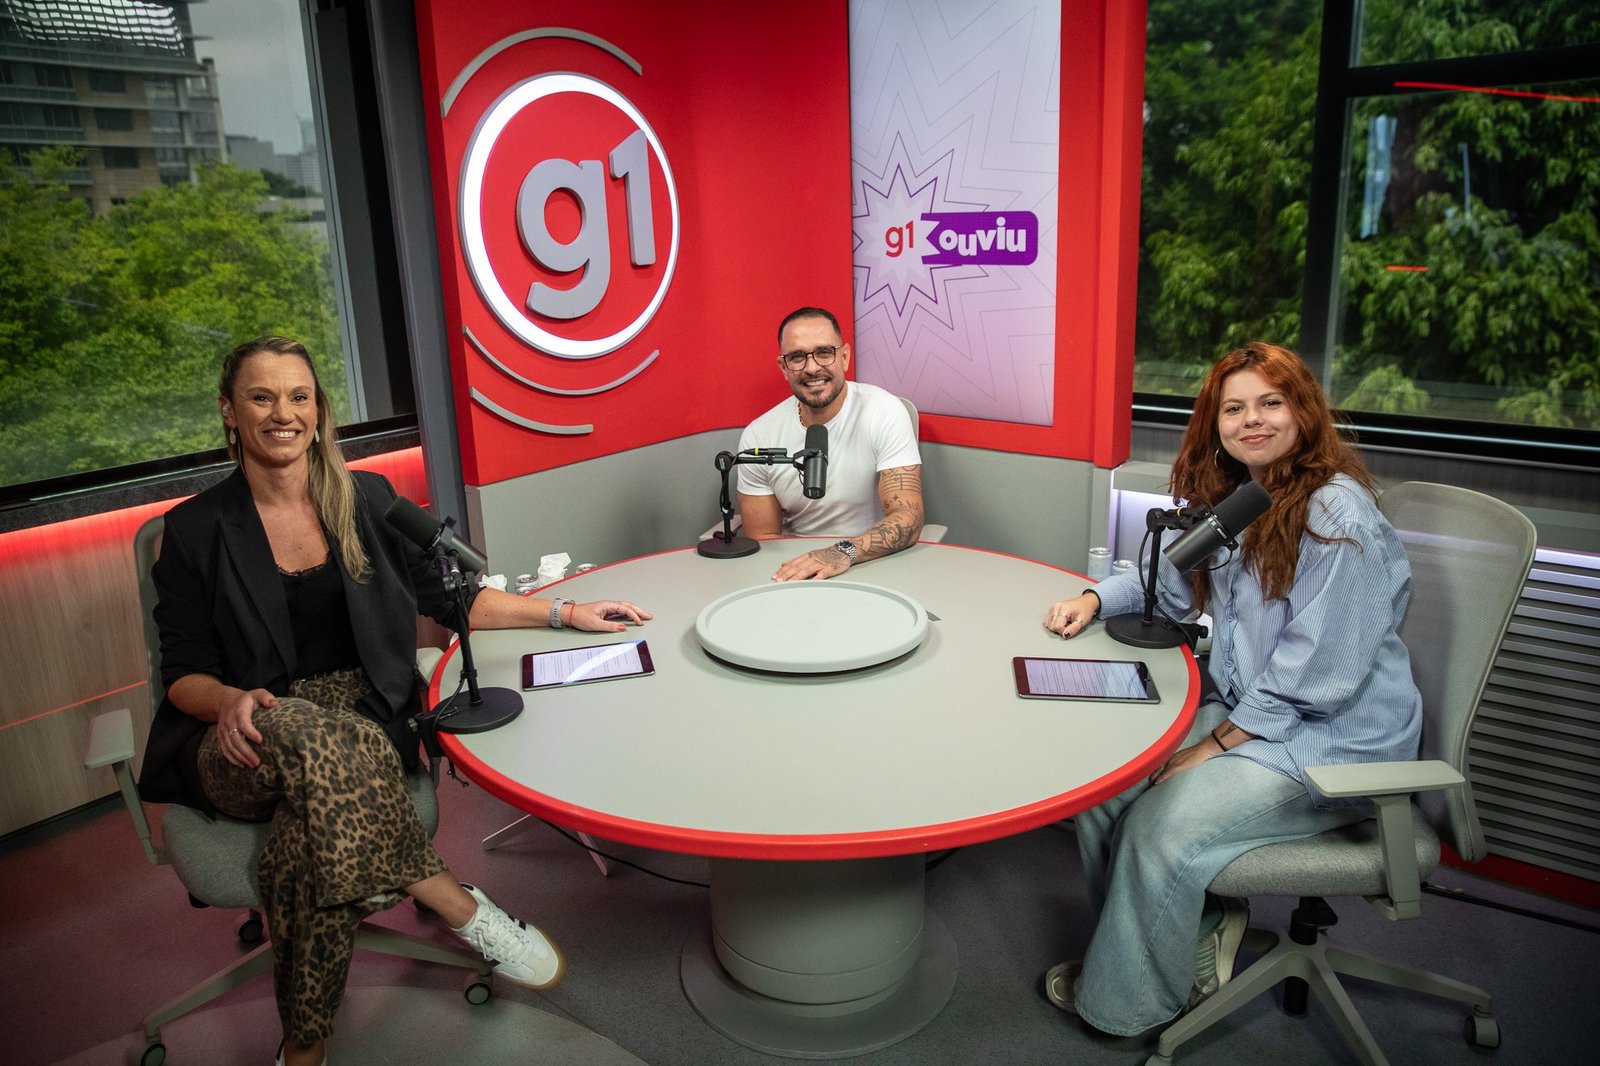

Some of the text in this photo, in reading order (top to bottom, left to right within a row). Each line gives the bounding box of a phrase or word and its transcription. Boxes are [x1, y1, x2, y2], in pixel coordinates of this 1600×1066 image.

[517, 129, 656, 319] g1
[885, 216, 1027, 258] g1 ouviu
